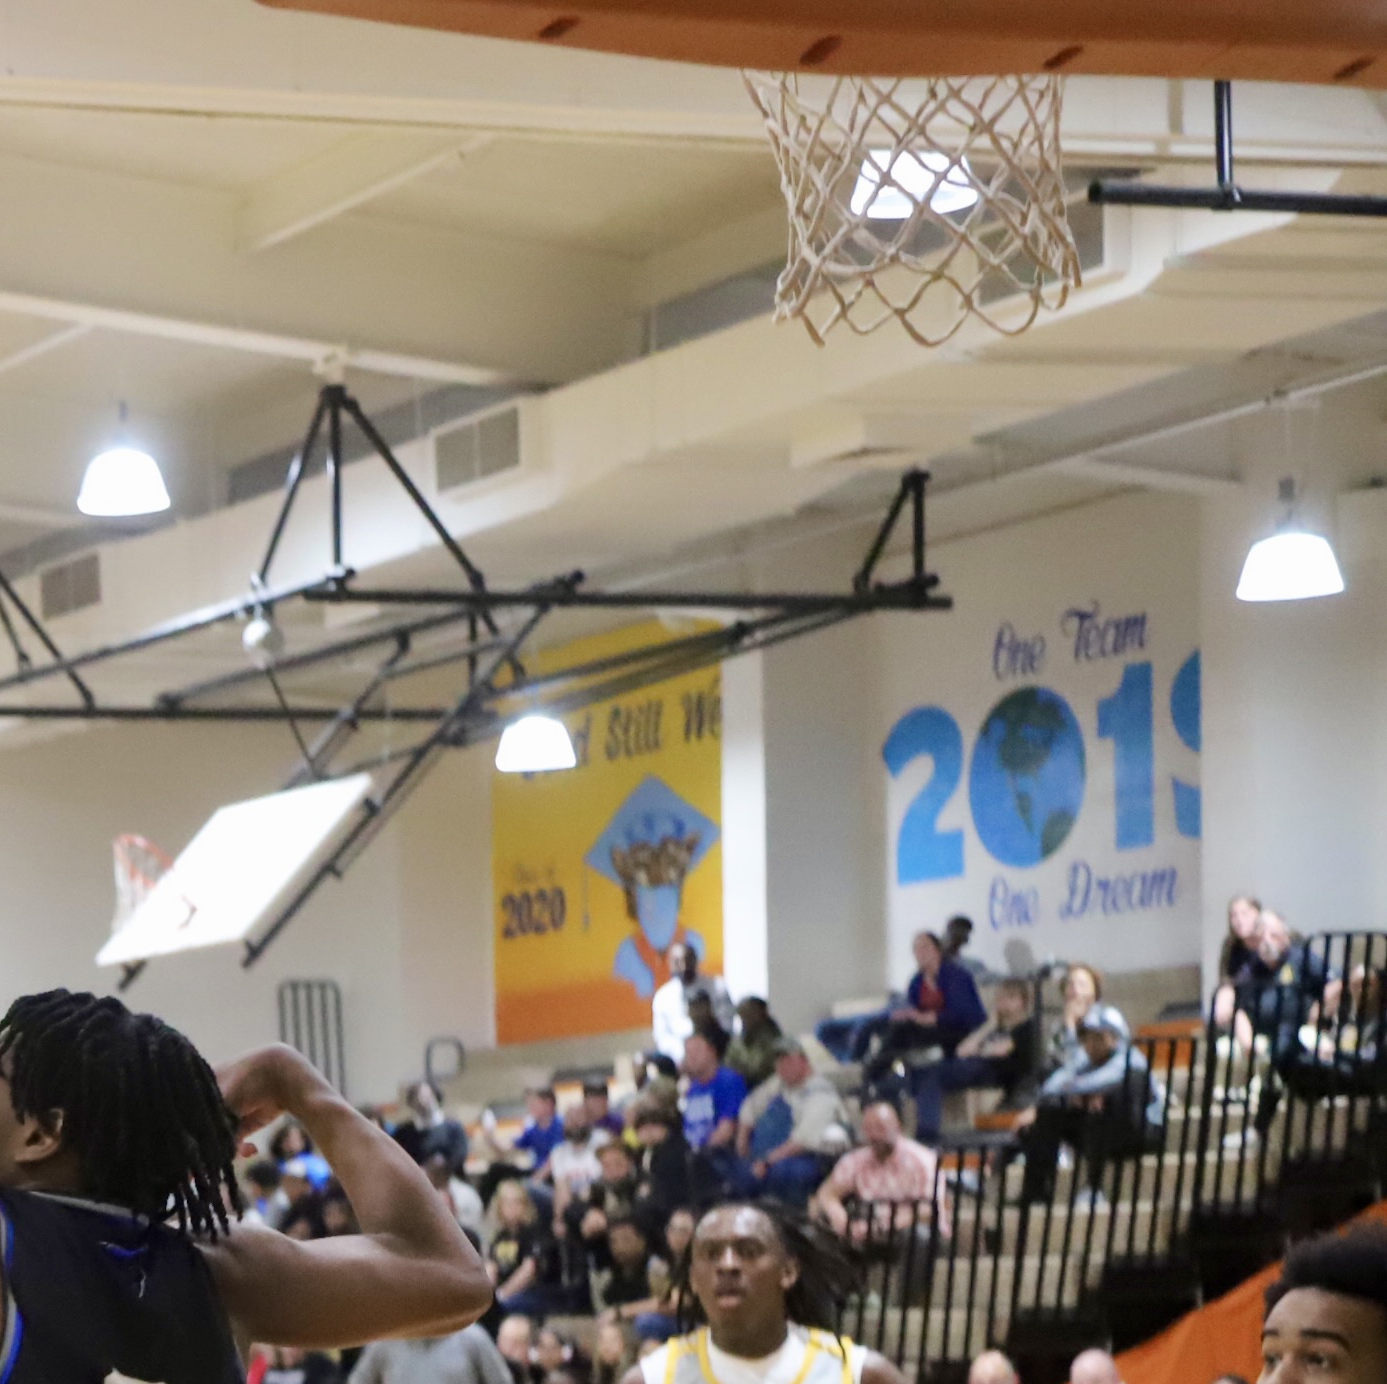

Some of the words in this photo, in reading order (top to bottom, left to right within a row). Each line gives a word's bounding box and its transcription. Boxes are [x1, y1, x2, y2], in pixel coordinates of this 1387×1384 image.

[992, 621, 1046, 681] One
[1060, 601, 1147, 662] Team
[501, 885, 567, 940] 2020
[988, 876, 1039, 930] One
[1059, 860, 1177, 919] Dream
